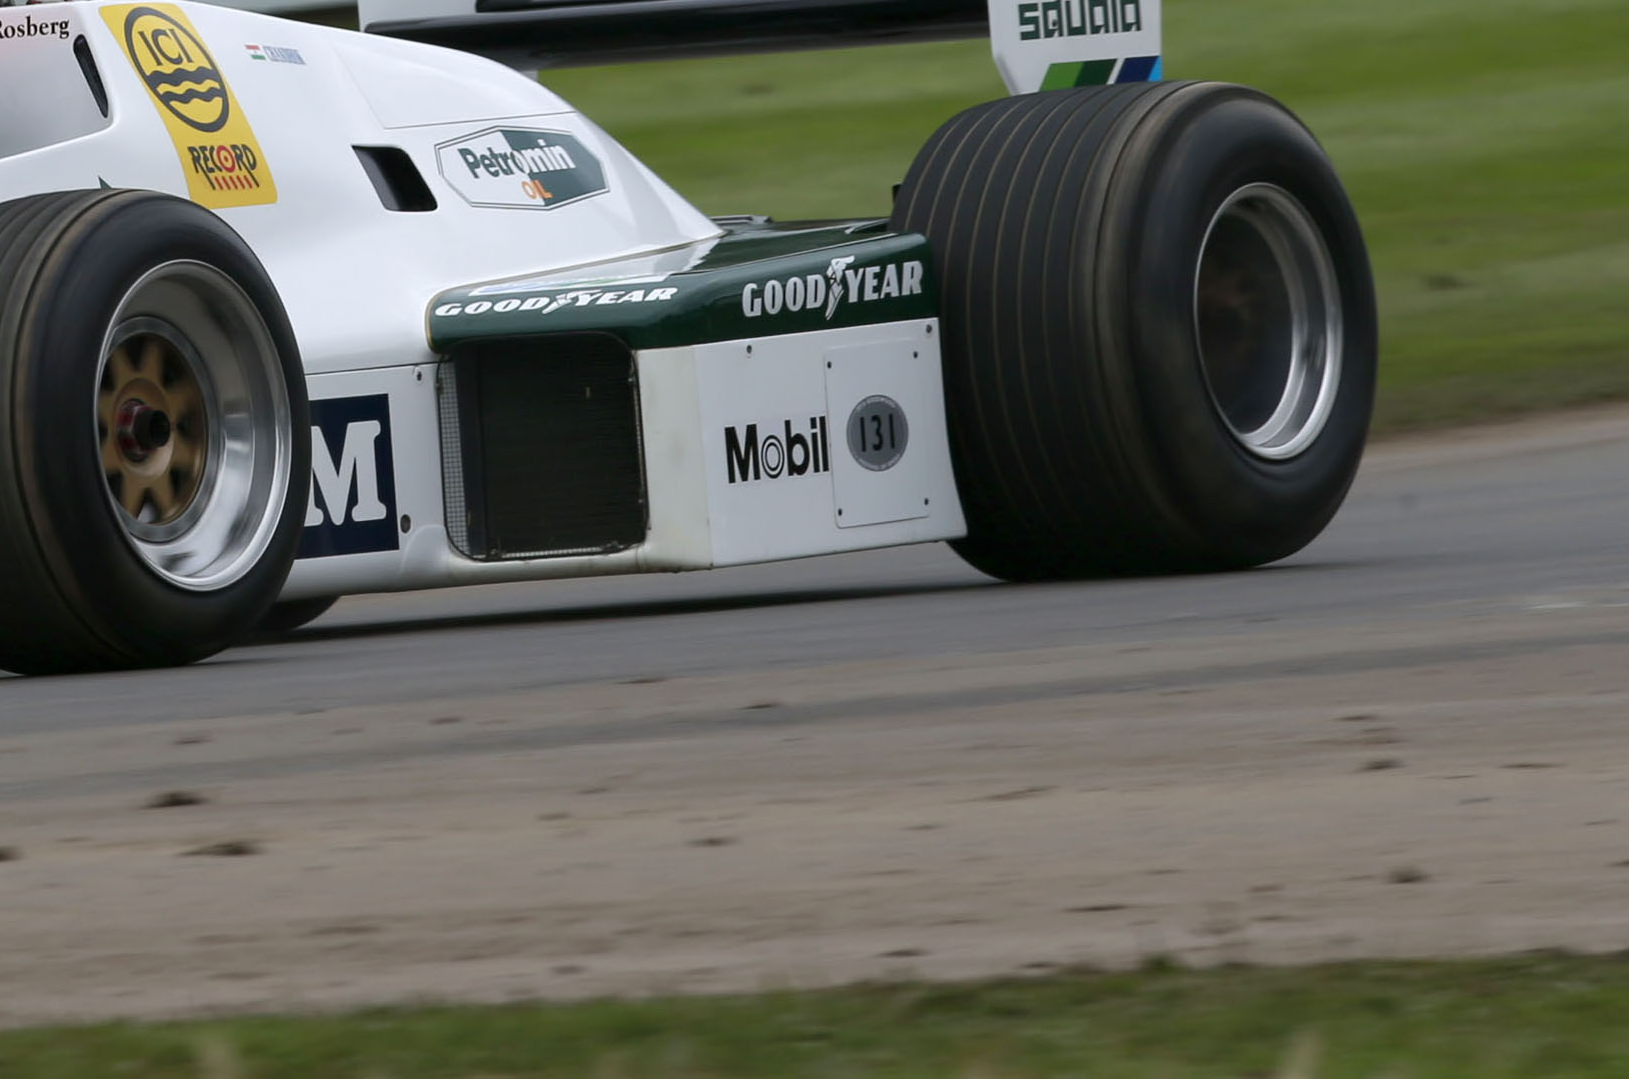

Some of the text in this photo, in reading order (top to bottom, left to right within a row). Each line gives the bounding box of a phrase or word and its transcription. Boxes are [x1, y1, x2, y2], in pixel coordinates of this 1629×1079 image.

[137, 27, 194, 67] ICI
[187, 143, 260, 191] RECORD
[457, 138, 577, 179] Petromin
[521, 179, 555, 200] OIL
[434, 286, 679, 317] GOODYEAR
[741, 255, 923, 321] GOODYEAR
[724, 415, 830, 484] Mobil
[859, 413, 896, 453] 131
